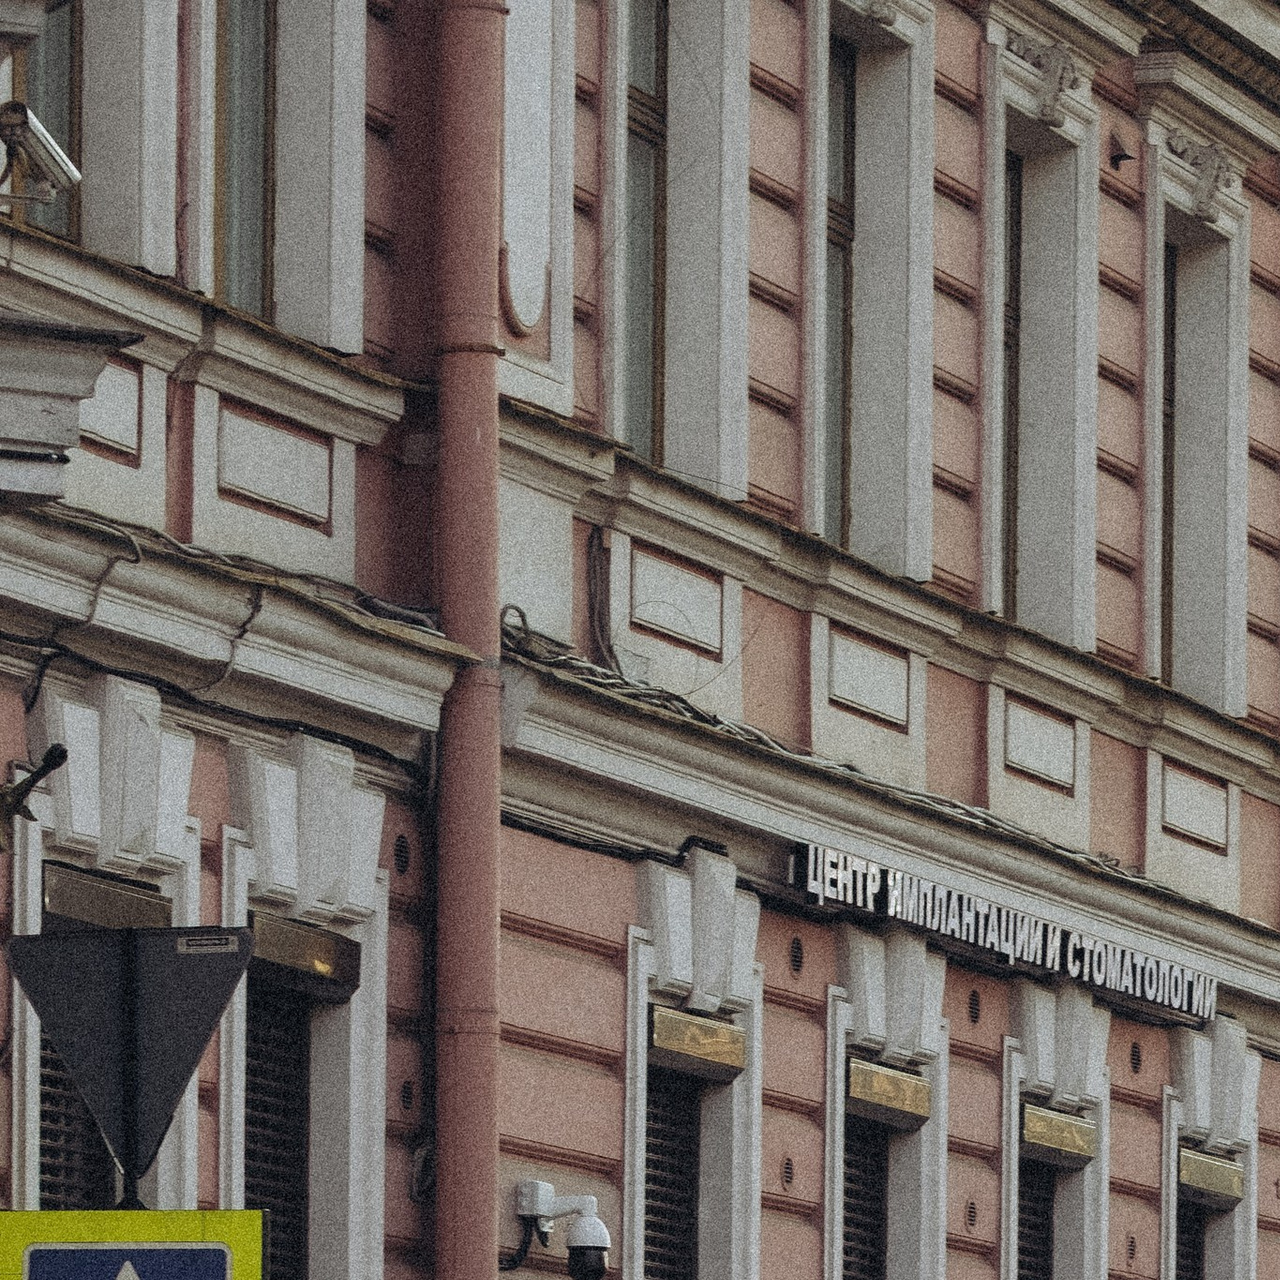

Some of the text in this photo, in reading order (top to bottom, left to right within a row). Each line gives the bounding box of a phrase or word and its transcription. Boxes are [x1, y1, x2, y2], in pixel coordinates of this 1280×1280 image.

[807, 844, 1218, 1020] ЦЕНТР ИМПЛАНТАЦИИ И СТОМАТОЛОГИИ
